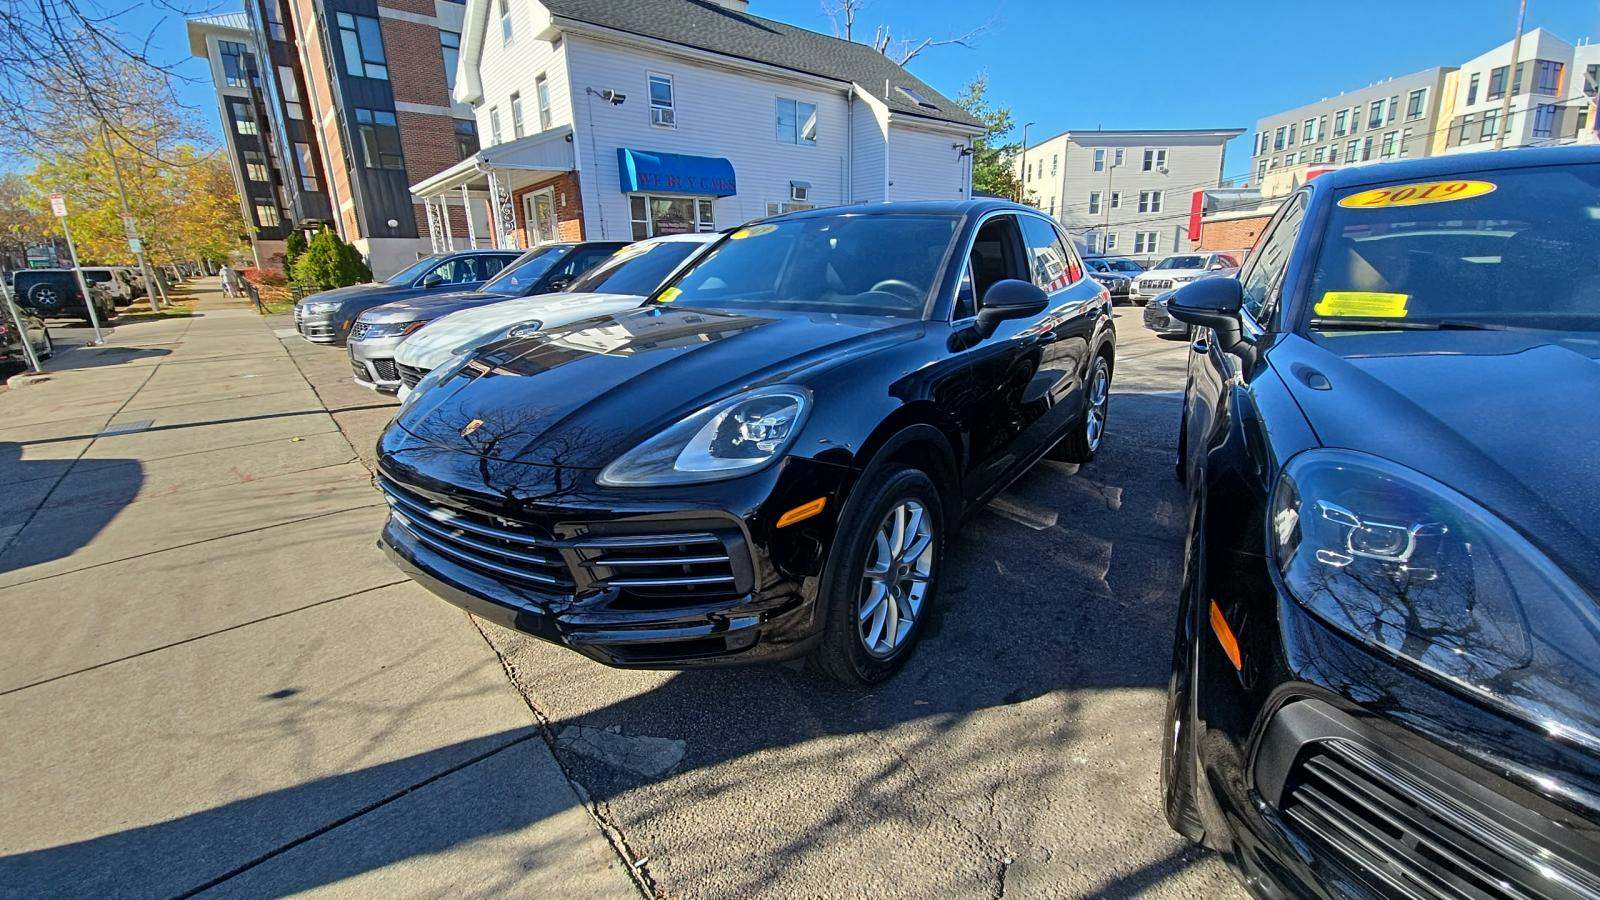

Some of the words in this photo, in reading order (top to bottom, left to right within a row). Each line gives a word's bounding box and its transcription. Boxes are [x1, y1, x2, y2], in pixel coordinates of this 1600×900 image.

[638, 173, 659, 186] WE
[666, 175, 697, 188] BUY
[701, 177, 736, 191] CARS
[1361, 183, 1469, 206] 2019
